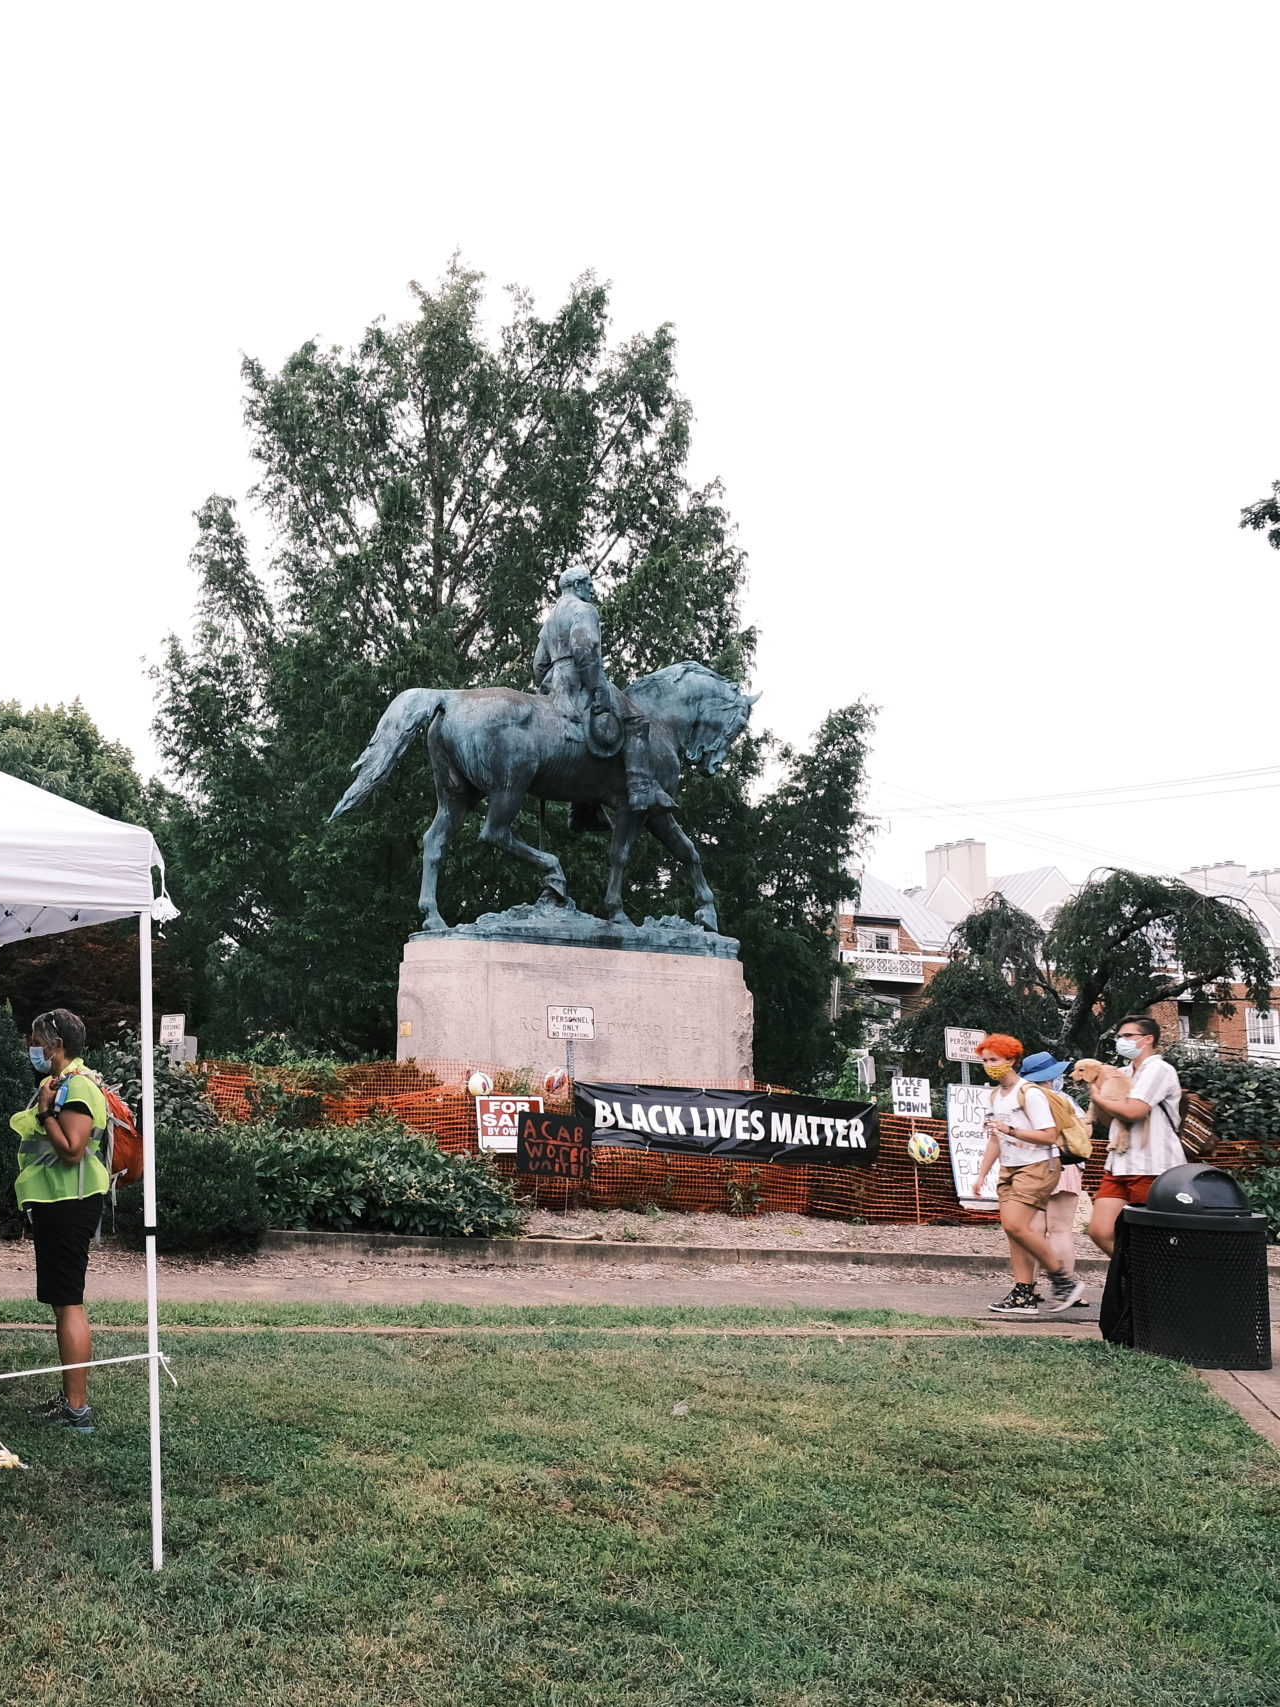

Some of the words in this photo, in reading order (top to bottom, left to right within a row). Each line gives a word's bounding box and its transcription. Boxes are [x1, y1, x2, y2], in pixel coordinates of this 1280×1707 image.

[551, 1015, 589, 1024] PERSONNEL
[562, 1024, 580, 1032] ONLY
[893, 1077, 922, 1088] TAKE
[897, 1086, 920, 1097] LEE
[949, 1087, 984, 1106] HONK
[489, 1101, 531, 1114] FOR
[898, 1100, 928, 1113] DOWN
[593, 1098, 687, 1136] BLACK
[689, 1106, 767, 1141] LIVES
[770, 1111, 868, 1149] MATTER
[487, 1127, 500, 1136] BY
[523, 1119, 585, 1143] ACAB
[951, 1126, 984, 1140] GEORGE
